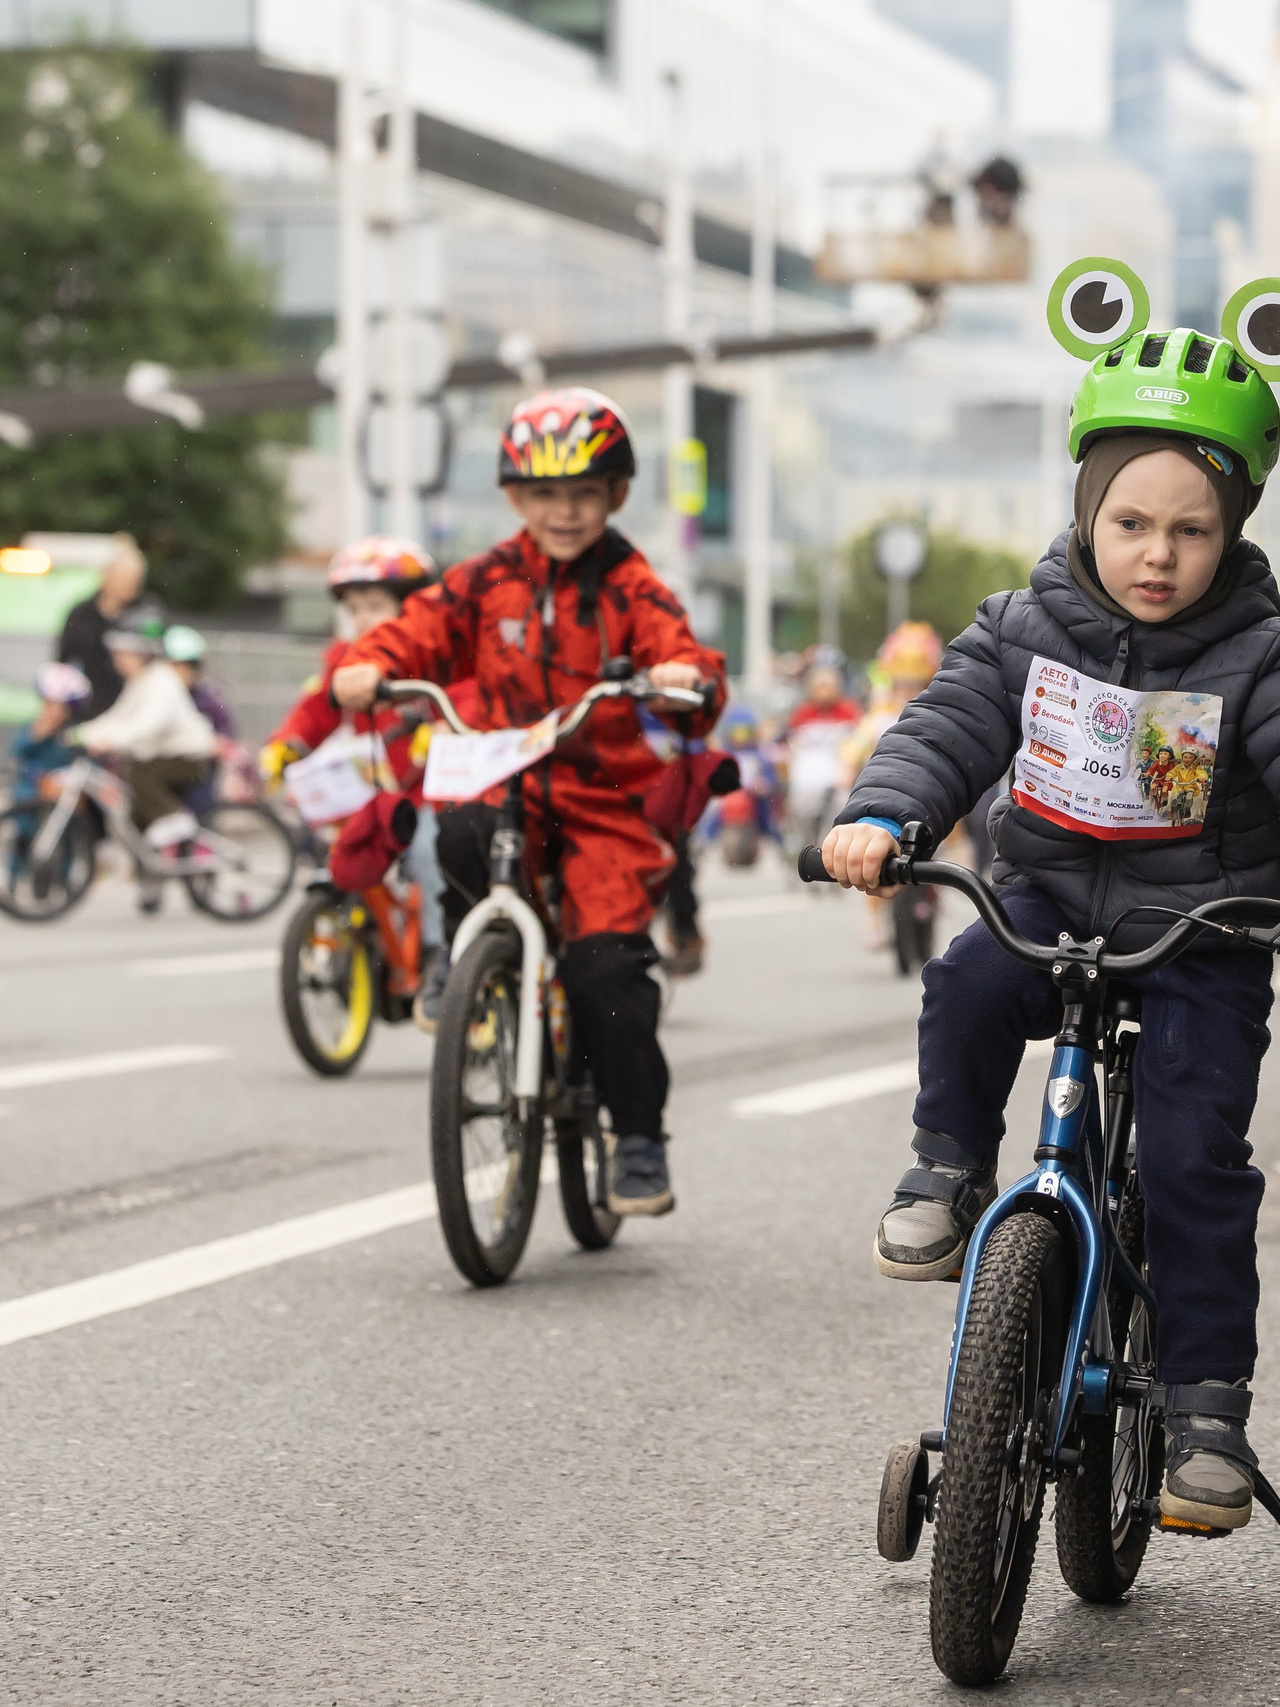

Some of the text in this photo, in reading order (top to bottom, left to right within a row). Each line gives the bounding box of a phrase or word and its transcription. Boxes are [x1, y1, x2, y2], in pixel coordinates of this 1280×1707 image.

[1141, 389, 1183, 402] ABUS
[1040, 666, 1069, 682] ЛЕТО
[1088, 692, 1136, 720] МОСКОВСКИЙ
[1041, 708, 1076, 727] Велобайк
[1085, 715, 1136, 753] ВЕЛОФЕСТИВАЛЬ
[1041, 748, 1065, 763] ДИКСИ
[1081, 757, 1122, 779] 1065
[1107, 801, 1144, 810] МОСКВА24
